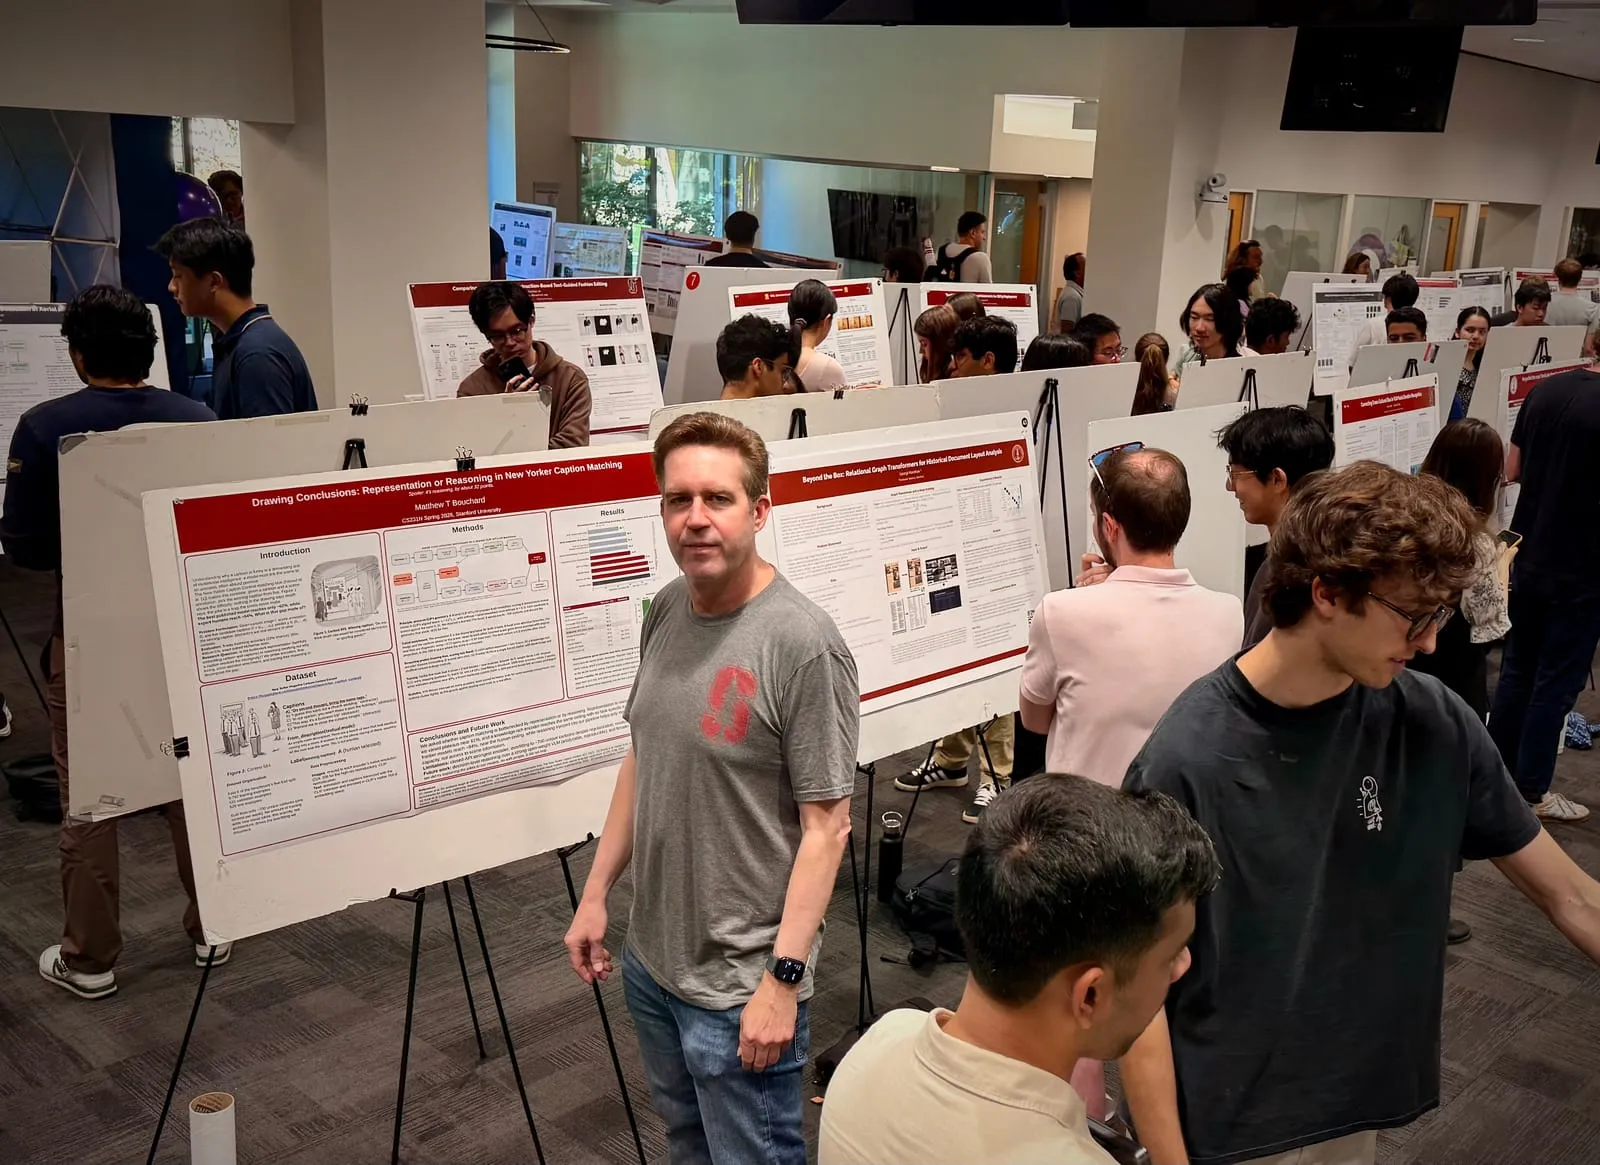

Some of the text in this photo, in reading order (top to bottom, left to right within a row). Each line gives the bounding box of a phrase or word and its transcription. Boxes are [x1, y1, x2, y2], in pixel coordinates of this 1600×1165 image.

[802, 473, 822, 484] Beyond
[824, 472, 832, 480] the
[833, 470, 845, 479] Box:
[846, 467, 871, 477] Relational
[872, 464, 887, 473] Graph
[887, 461, 918, 471] Transformers
[926, 456, 947, 465] Historical
[948, 453, 970, 462] Document
[971, 451, 985, 460] Layout
[986, 448, 1002, 457] Analysis
[251, 494, 294, 509] Drawing
[296, 487, 359, 502] Conclusions:
[362, 480, 431, 497] Representation
[446, 473, 492, 488] Reasoning
[494, 472, 502, 480] in
[505, 470, 523, 479] New
[525, 467, 551, 477] Yorker
[553, 464, 585, 476] Caption
[586, 460, 622, 472] Matching
[414, 500, 444, 511] Matthew
[452, 495, 486, 506] Bouchard
[401, 515, 422, 523] CS231N
[423, 513, 439, 522] Spring
[455, 509, 476, 517] Stanford
[477, 506, 501, 515] University
[600, 507, 624, 516] Results
[451, 522, 484, 533] Methods
[259, 546, 310, 559] Introduction
[285, 669, 316, 682] Dataset
[282, 701, 304, 710] Captions
[419, 729, 456, 743] Conclusions
[470, 722, 489, 731] Future
[490, 719, 505, 727] Work
